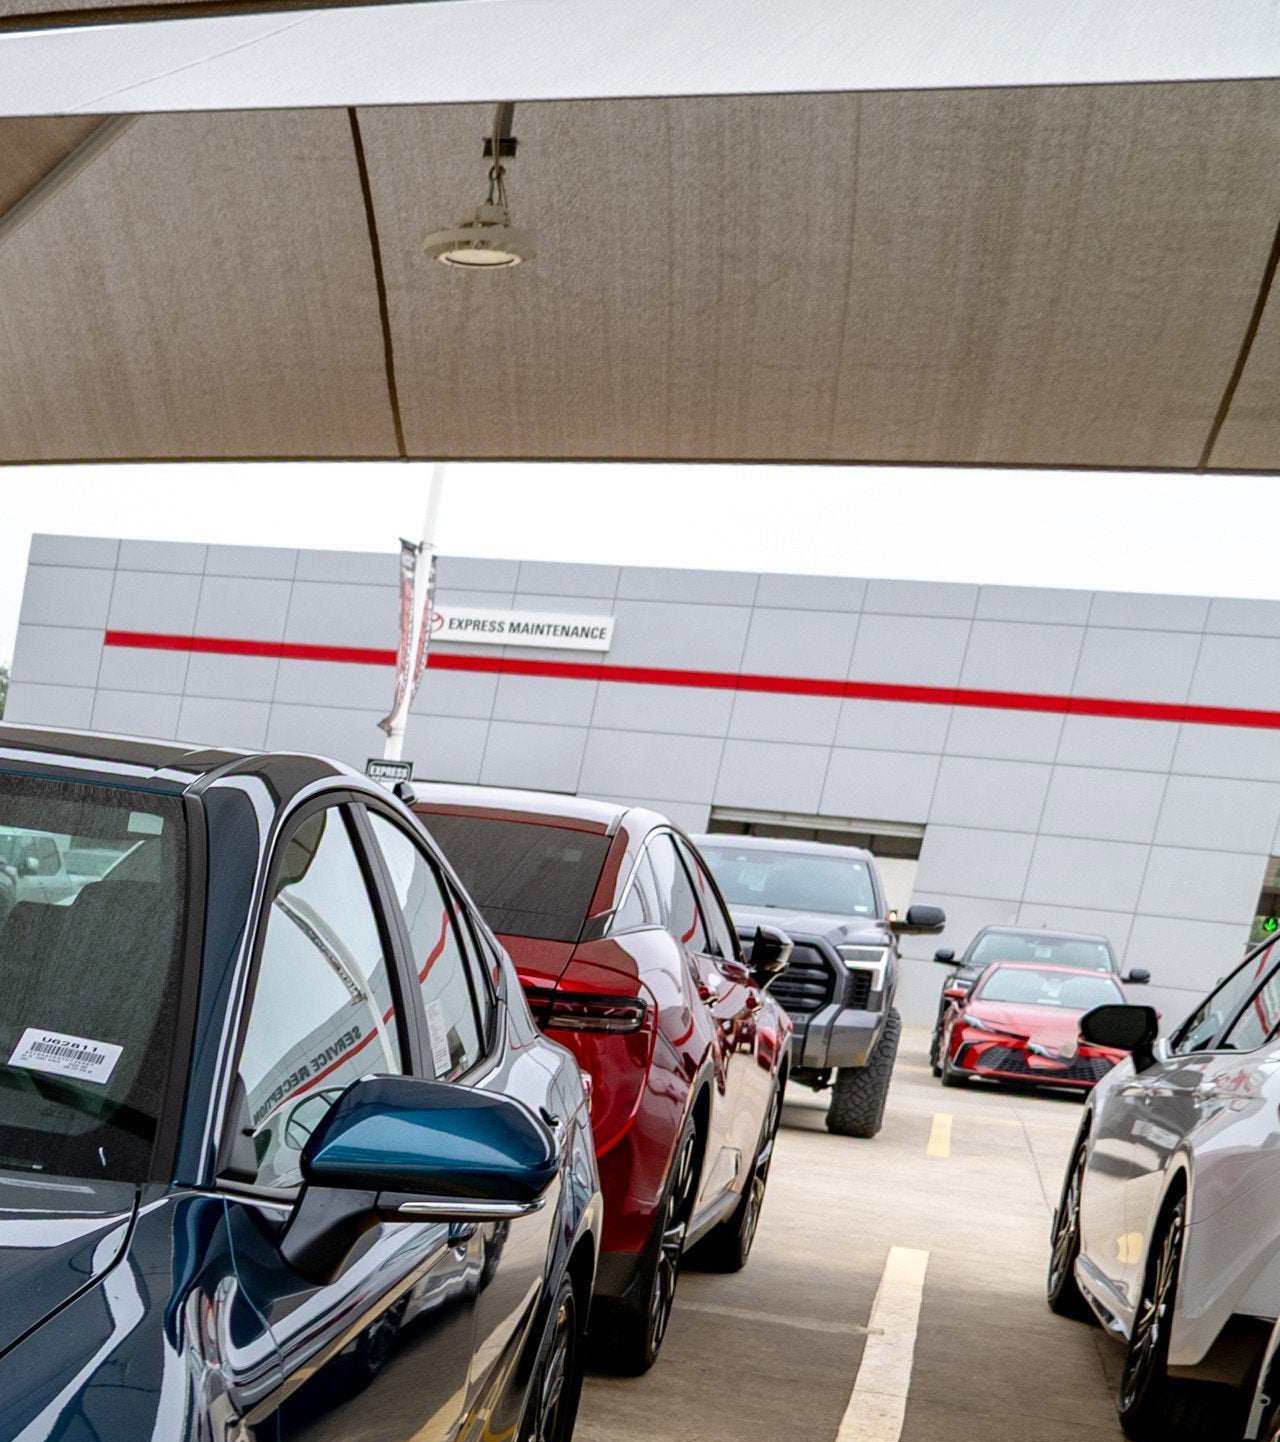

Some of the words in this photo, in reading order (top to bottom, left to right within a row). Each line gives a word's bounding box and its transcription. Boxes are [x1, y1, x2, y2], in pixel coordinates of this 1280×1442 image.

[448, 617, 505, 634] EXPRESS
[508, 621, 608, 640] MAINTENANCE
[370, 765, 408, 778] EXPRESS
